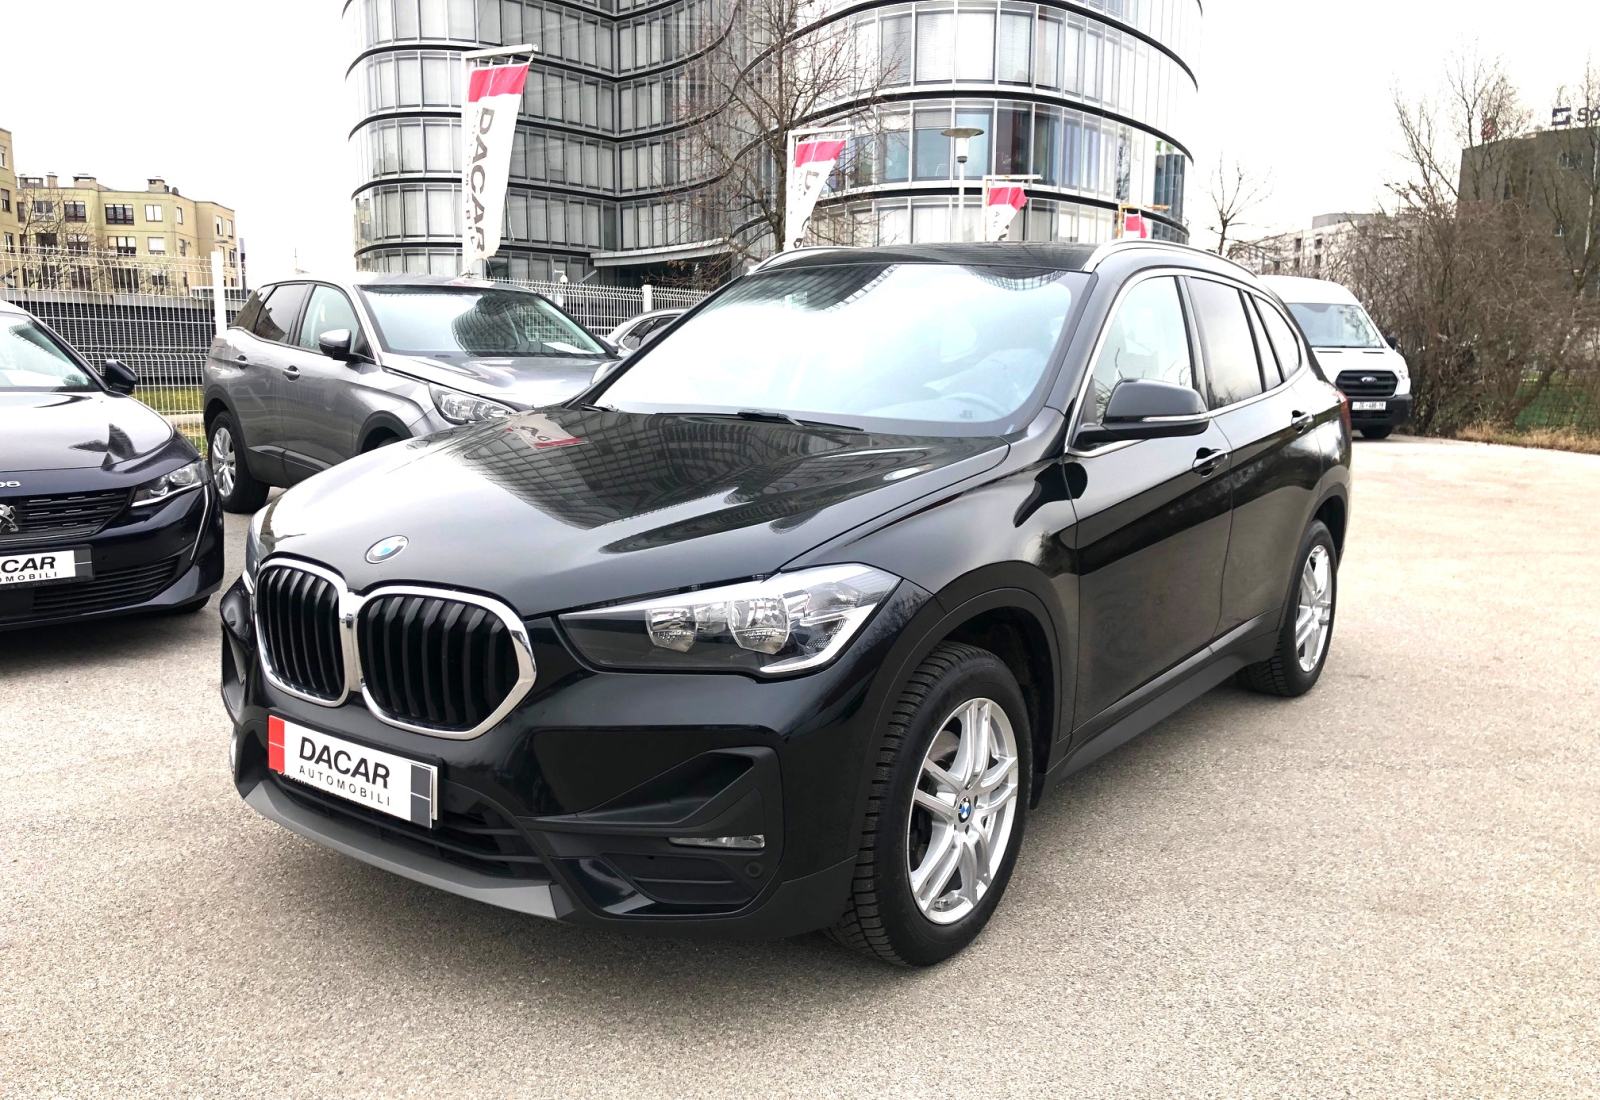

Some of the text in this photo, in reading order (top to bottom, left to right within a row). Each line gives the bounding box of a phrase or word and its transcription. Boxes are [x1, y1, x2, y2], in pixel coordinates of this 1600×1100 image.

[470, 107, 495, 252] DACAR
[0, 571, 57, 582] MOBILI
[299, 736, 390, 789] DACAR
[299, 765, 390, 806] AUTOMOBILI
